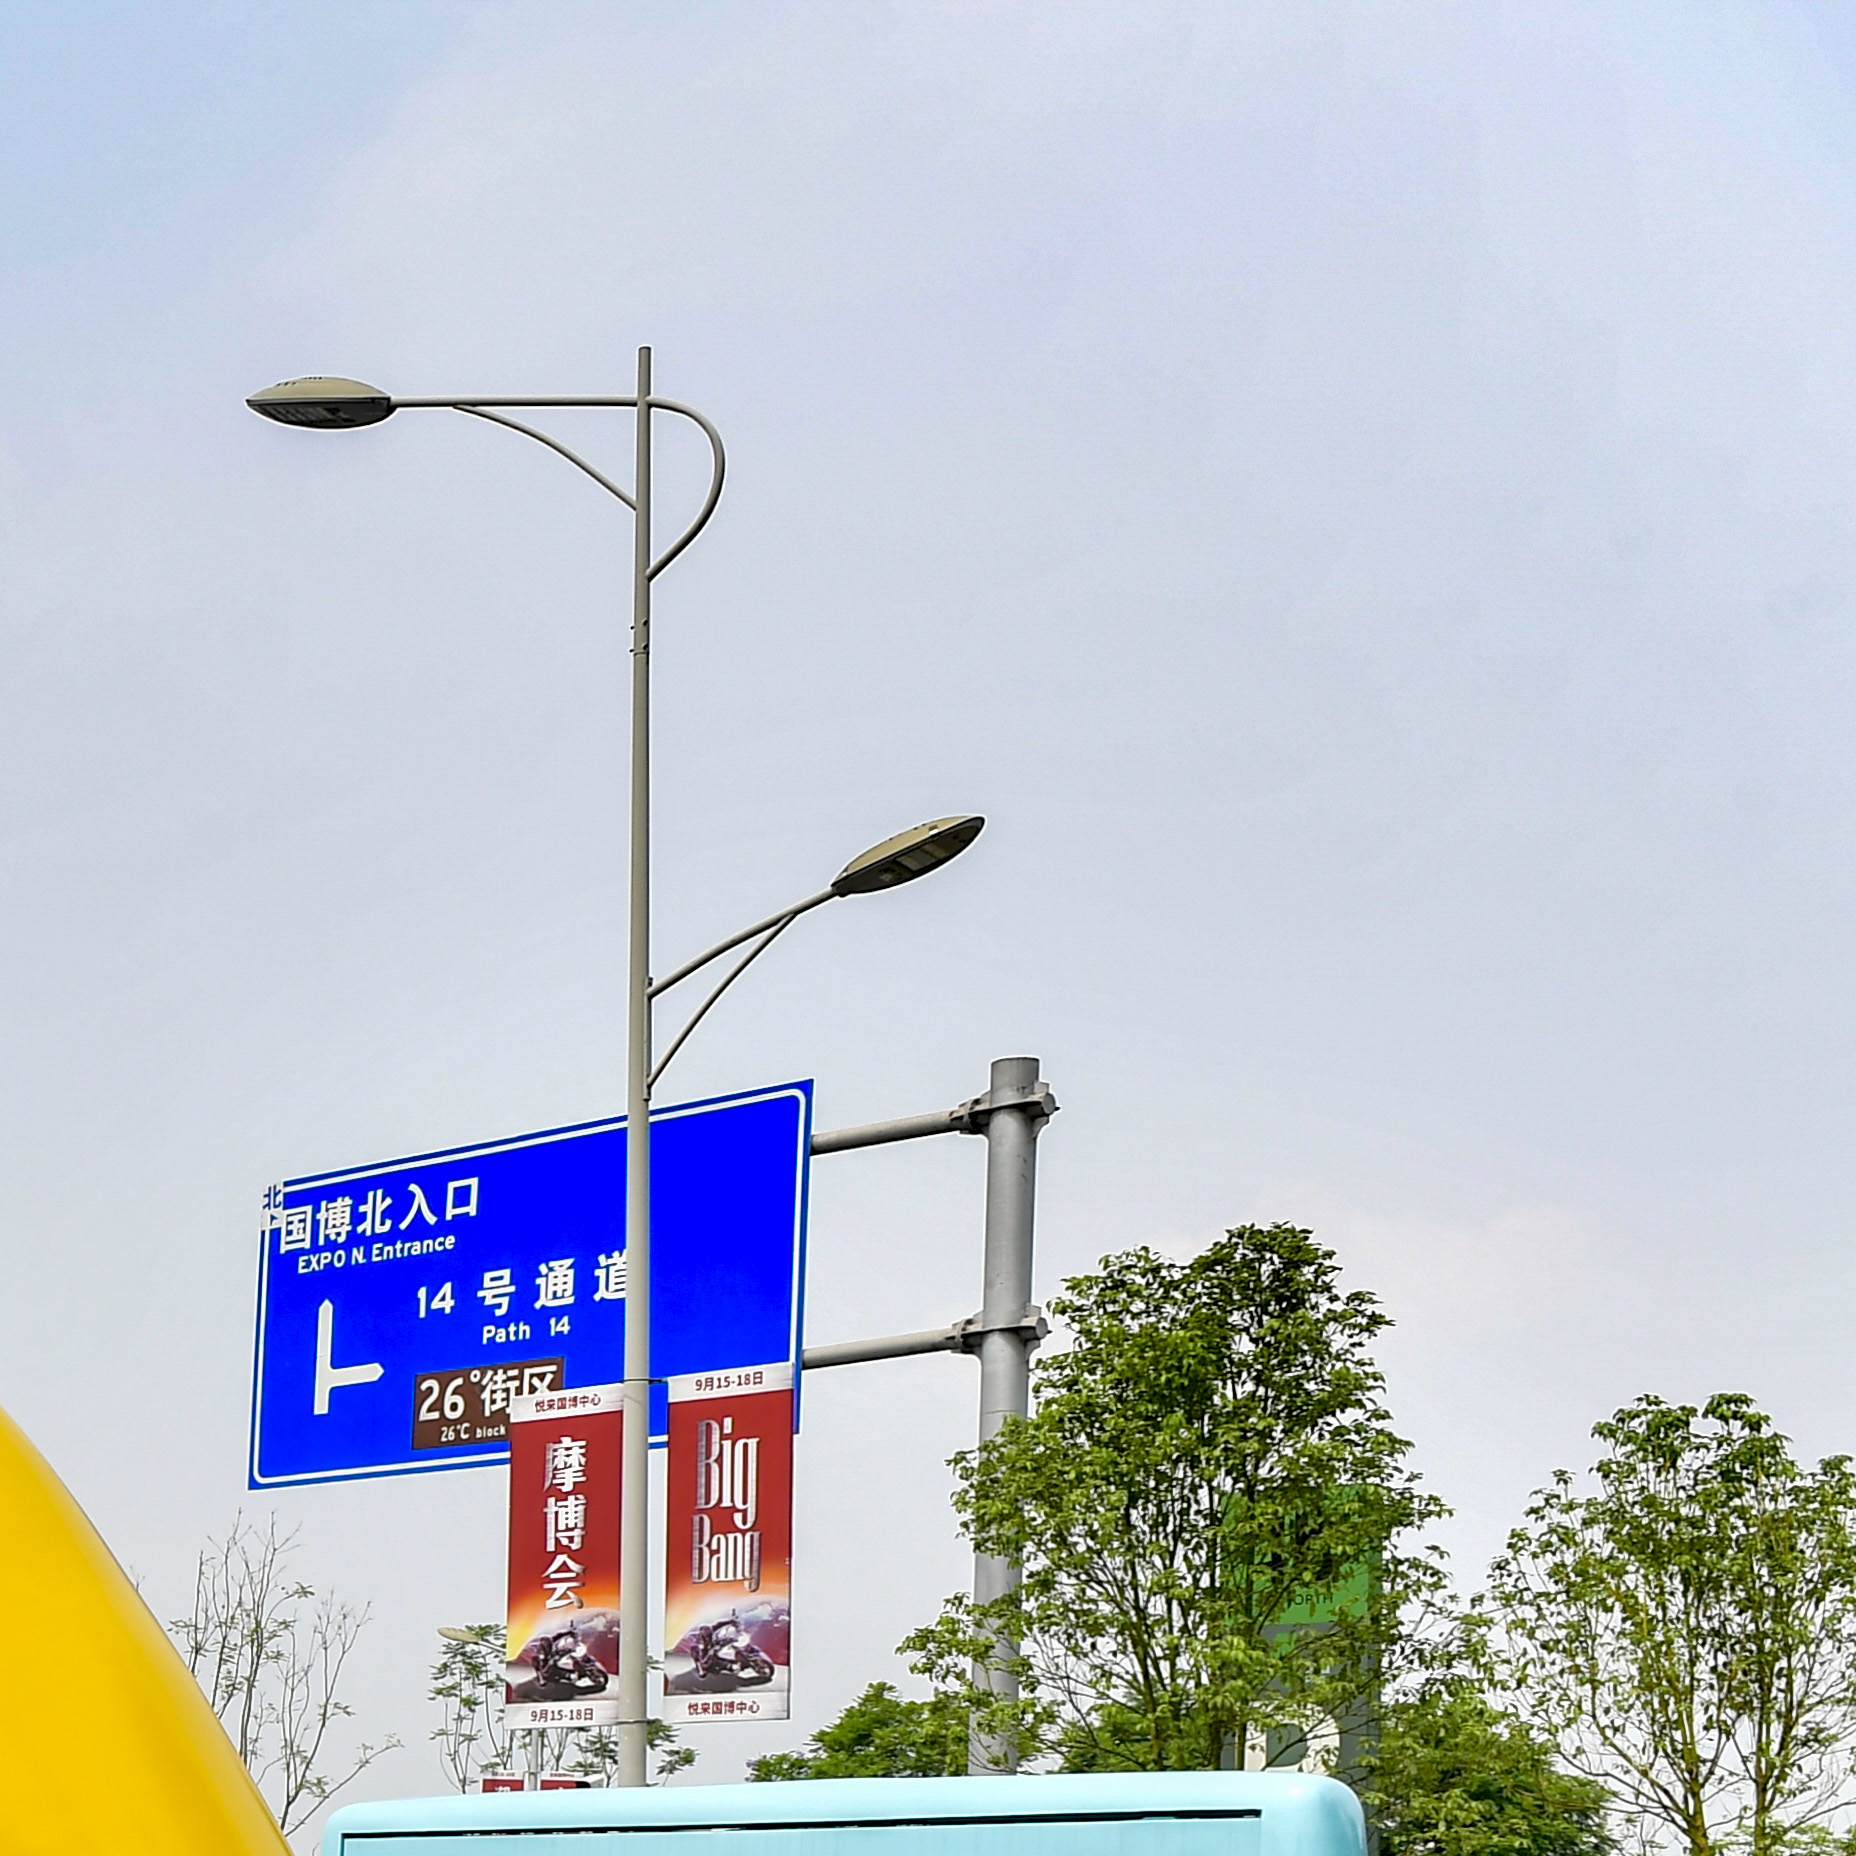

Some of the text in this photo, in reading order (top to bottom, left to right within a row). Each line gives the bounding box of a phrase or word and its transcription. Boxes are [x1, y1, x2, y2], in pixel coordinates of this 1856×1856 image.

[263, 1184, 282, 1211] 北
[280, 1177, 479, 1254] 国博北入口
[298, 1250, 346, 1274] EXPO
[372, 1235, 456, 1263] Entrance
[482, 1315, 571, 1345] Path 14
[695, 1371, 764, 1393] 9月15-18日
[534, 1393, 602, 1413] 悦来国博中心
[475, 1424, 507, 1439] block
[695, 1416, 761, 1530] Big
[541, 1436, 588, 1610] 摩博会
[691, 1513, 762, 1593] Bang
[530, 1707, 594, 1723] 9月15-18日
[687, 1700, 761, 1716] 悦来国博中心
